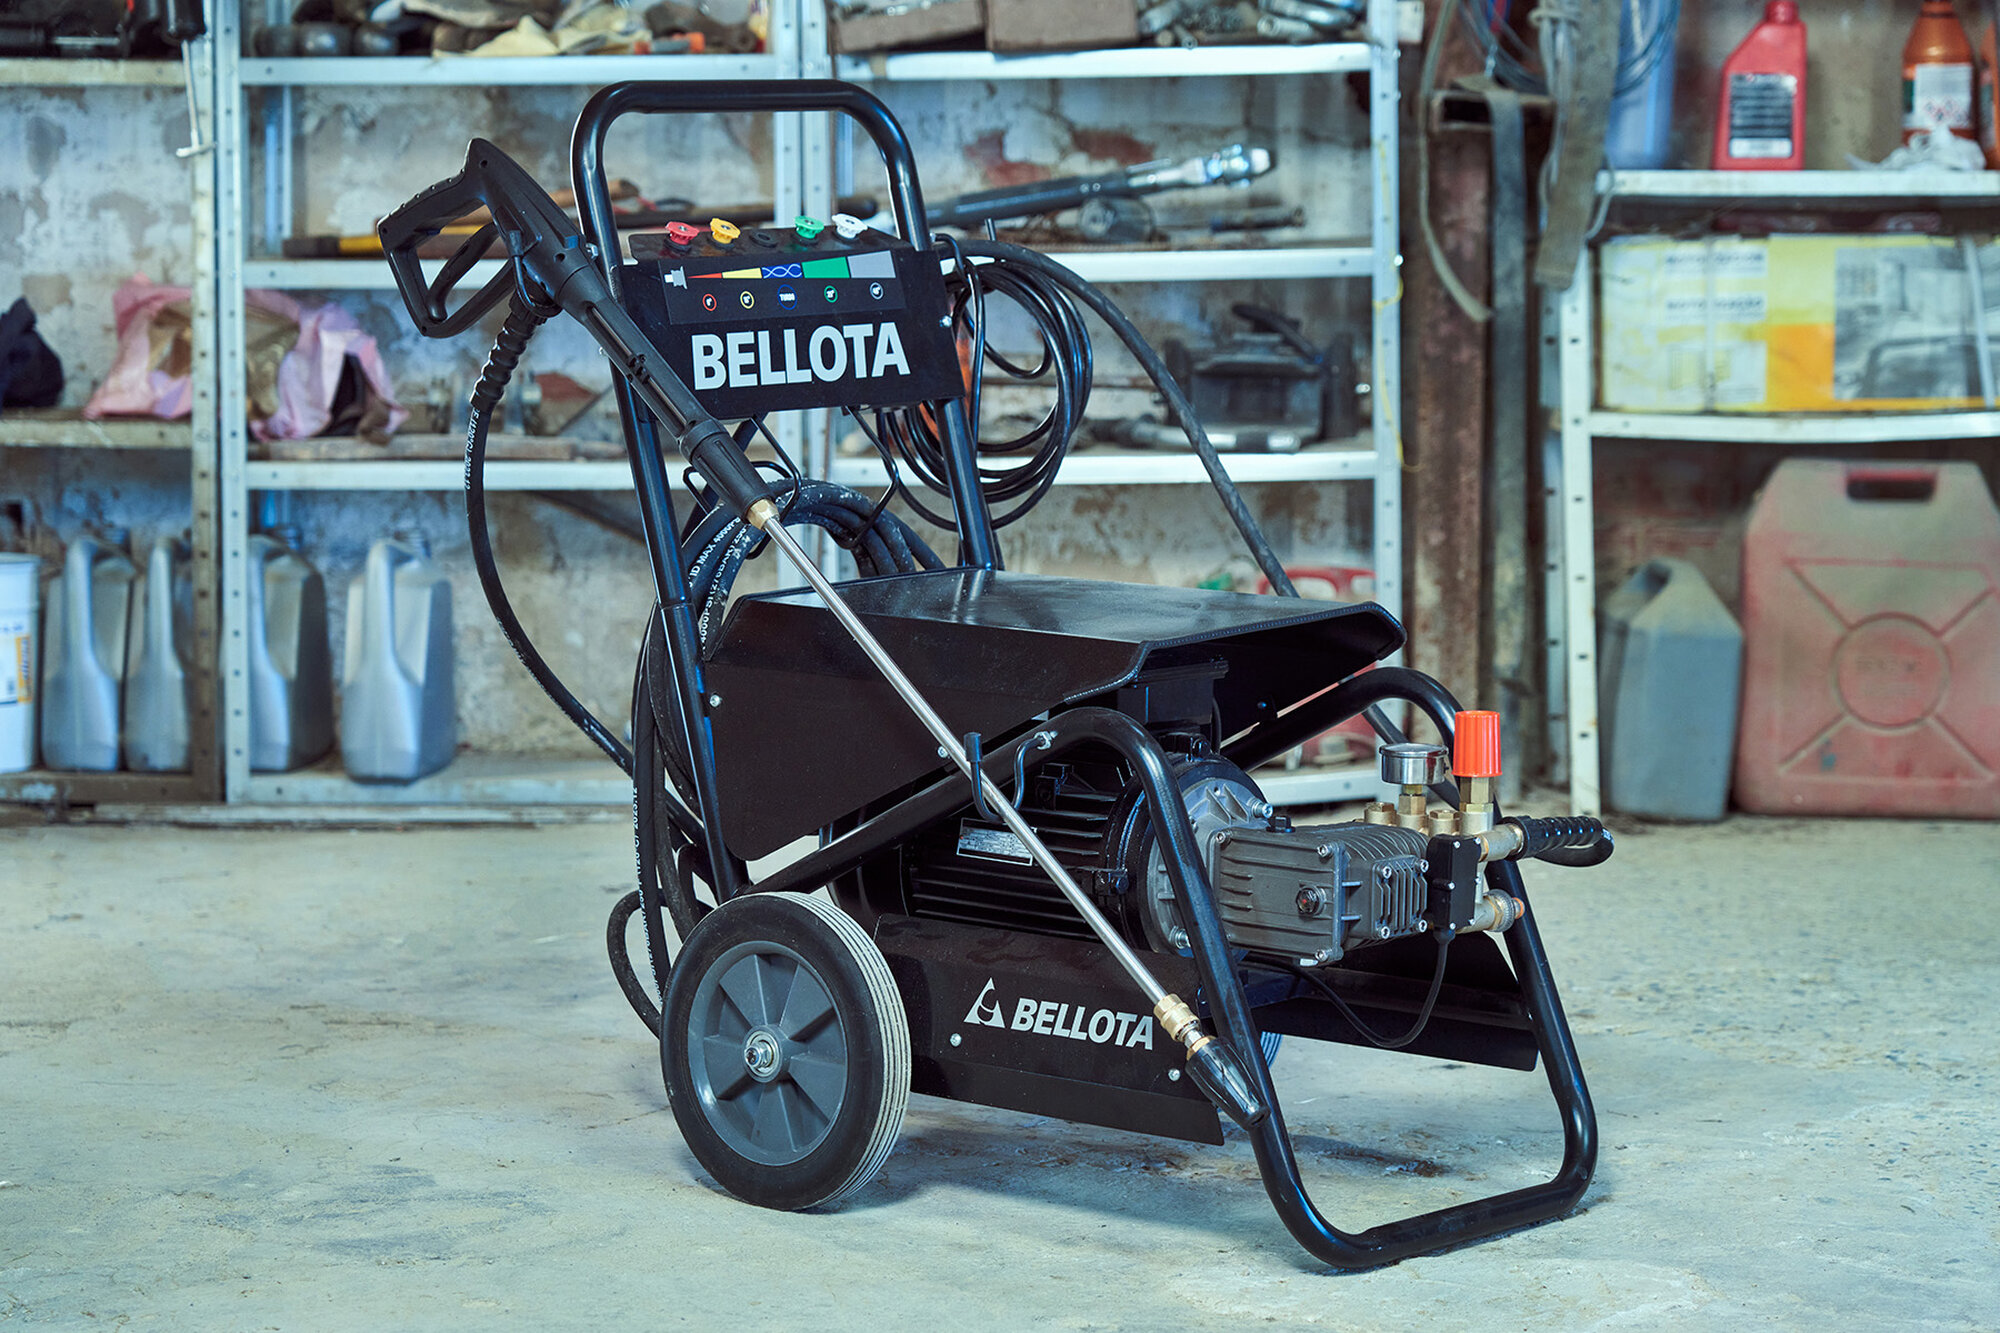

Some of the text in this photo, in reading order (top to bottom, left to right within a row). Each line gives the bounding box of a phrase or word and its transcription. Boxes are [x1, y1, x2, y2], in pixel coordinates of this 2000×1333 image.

[691, 322, 911, 390] BELLOTA
[697, 543, 717, 565] MAX
[713, 516, 742, 543] 4000PS
[1011, 998, 1153, 1051] BELLOTA
